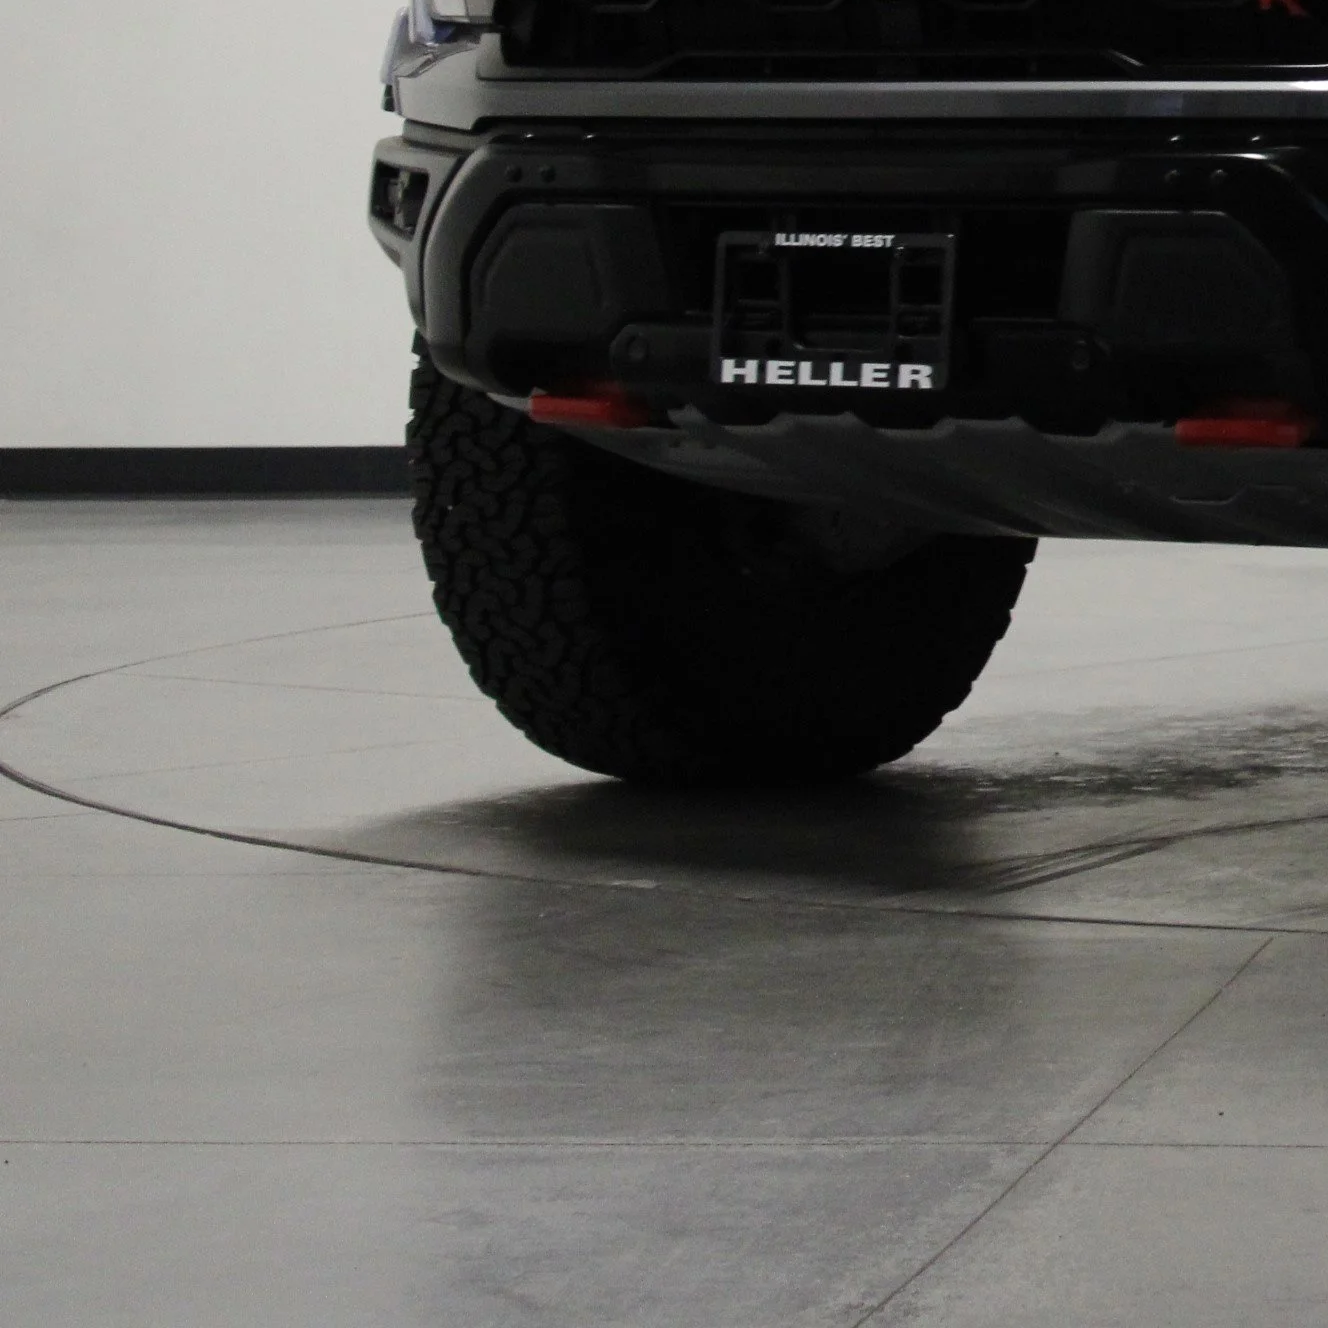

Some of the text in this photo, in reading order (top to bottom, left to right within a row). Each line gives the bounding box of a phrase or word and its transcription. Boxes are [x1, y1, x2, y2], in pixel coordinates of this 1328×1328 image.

[774, 232, 896, 248] ILLINOIS' BEST
[720, 357, 934, 390] HELLER
